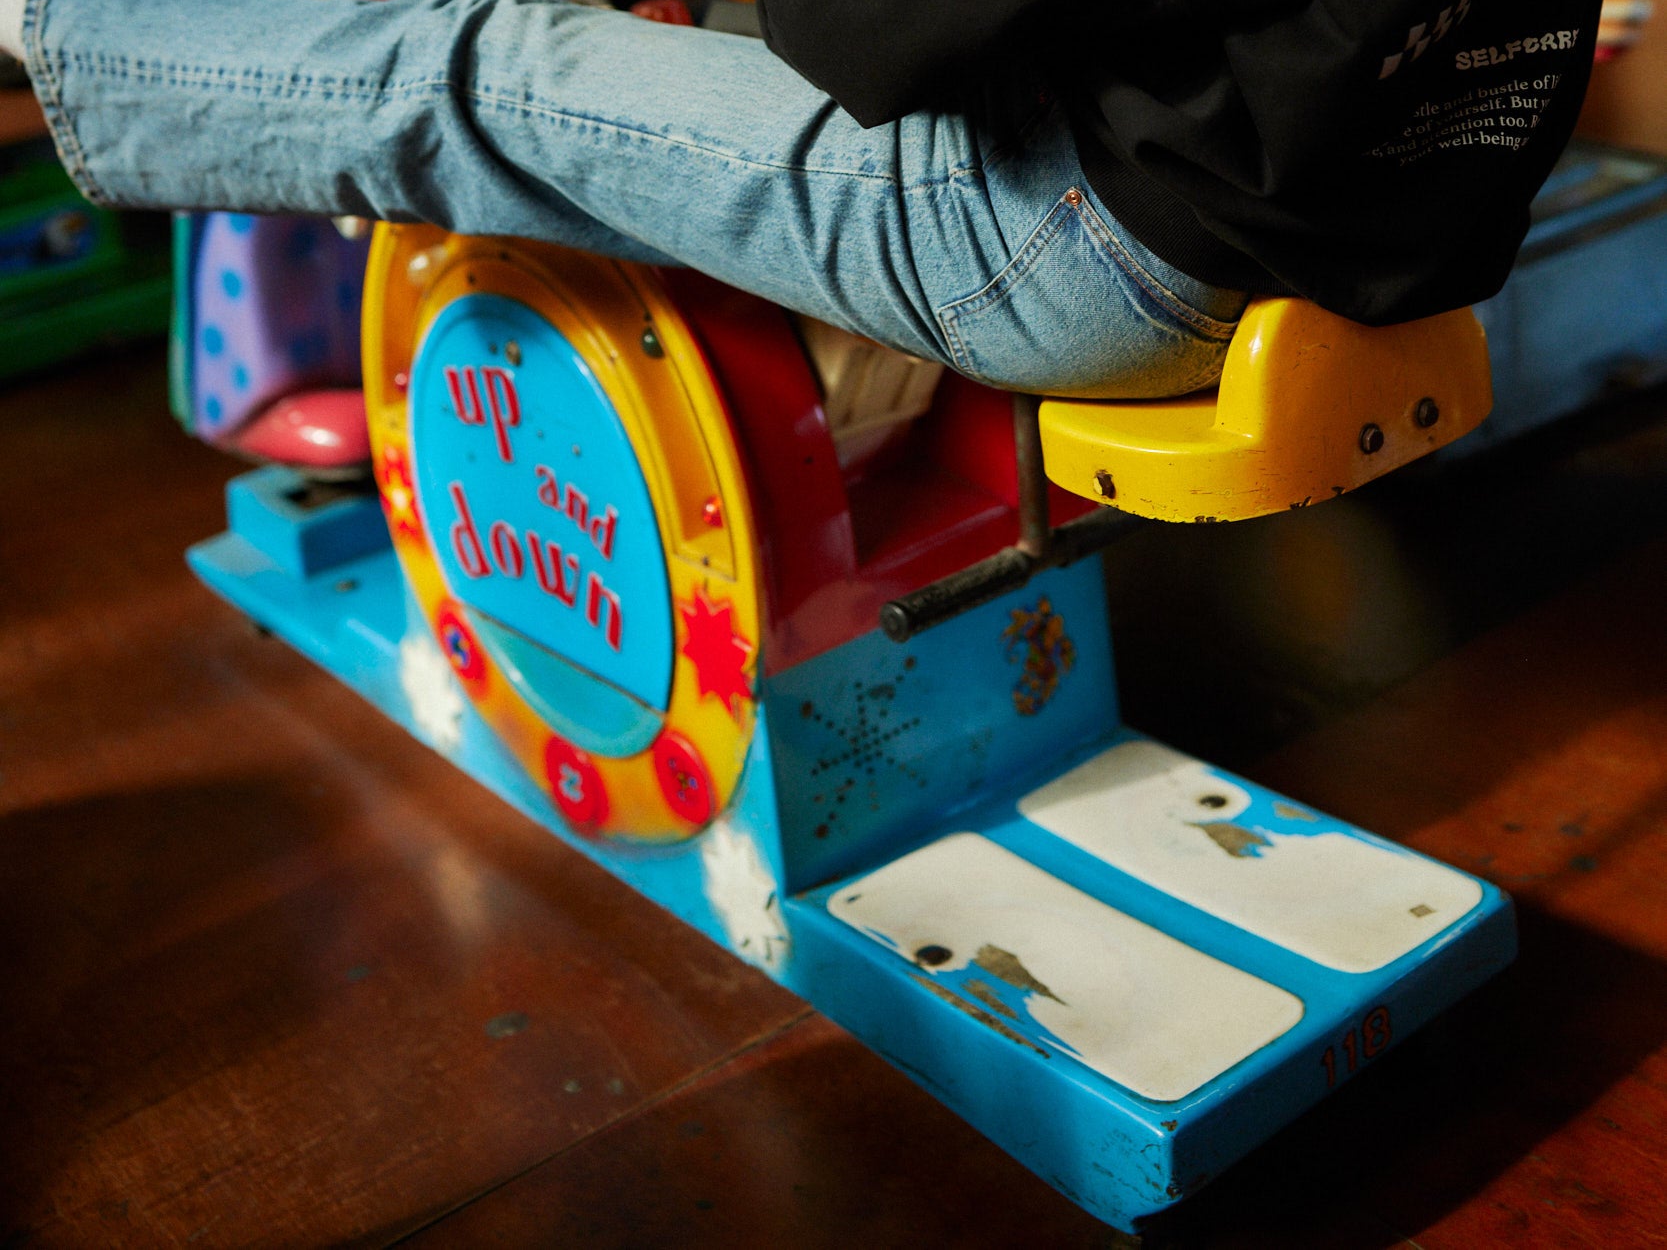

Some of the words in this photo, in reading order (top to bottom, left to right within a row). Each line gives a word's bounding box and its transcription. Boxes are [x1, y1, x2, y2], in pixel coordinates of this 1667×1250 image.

[1477, 78, 1529, 99] bustle
[1532, 74, 1551, 91] of
[1510, 95, 1539, 109] But
[1386, 139, 1417, 156] and
[1498, 114, 1528, 128] too.
[1437, 131, 1522, 151] well-being
[443, 363, 522, 465] up
[533, 463, 620, 562] and
[448, 480, 625, 654] down
[1322, 1004, 1392, 1089] 118
